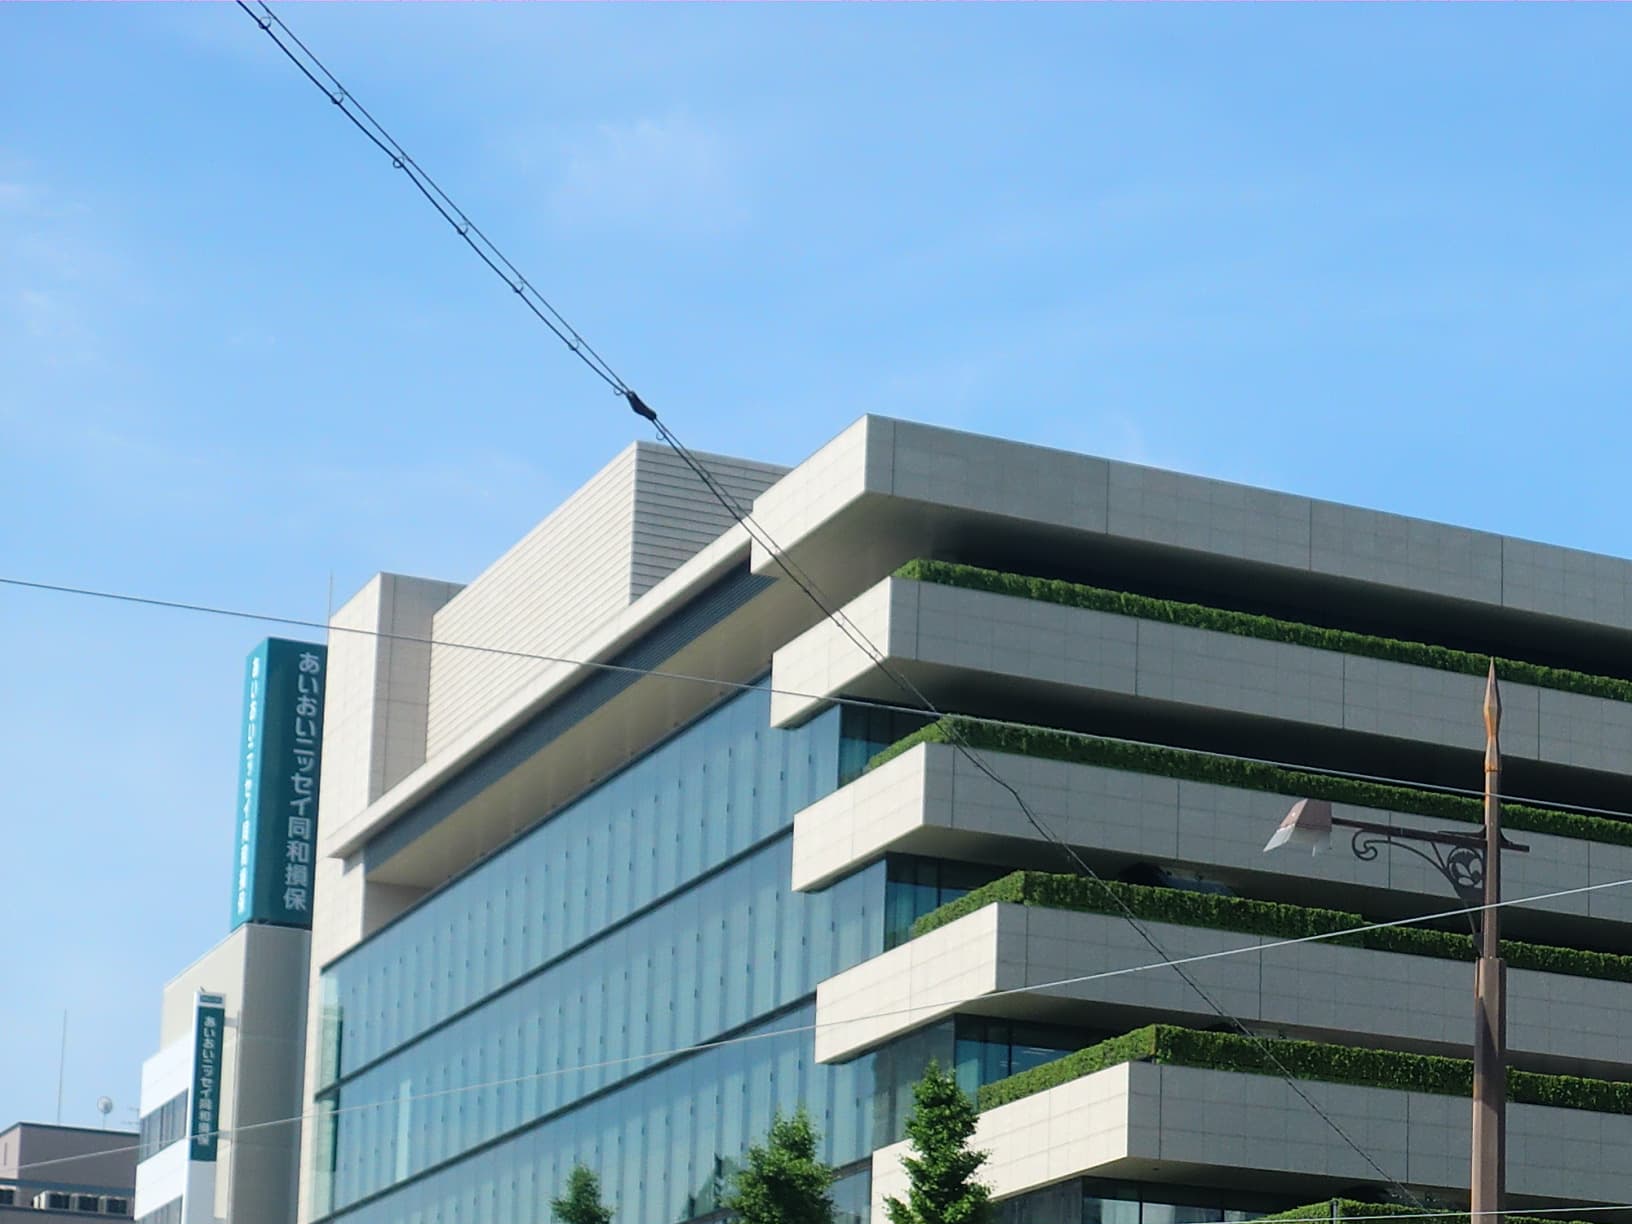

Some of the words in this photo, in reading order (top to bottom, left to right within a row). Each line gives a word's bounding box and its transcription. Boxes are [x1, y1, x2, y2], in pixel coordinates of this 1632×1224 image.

[283, 652, 320, 911] あいおいニッセイ同和損保
